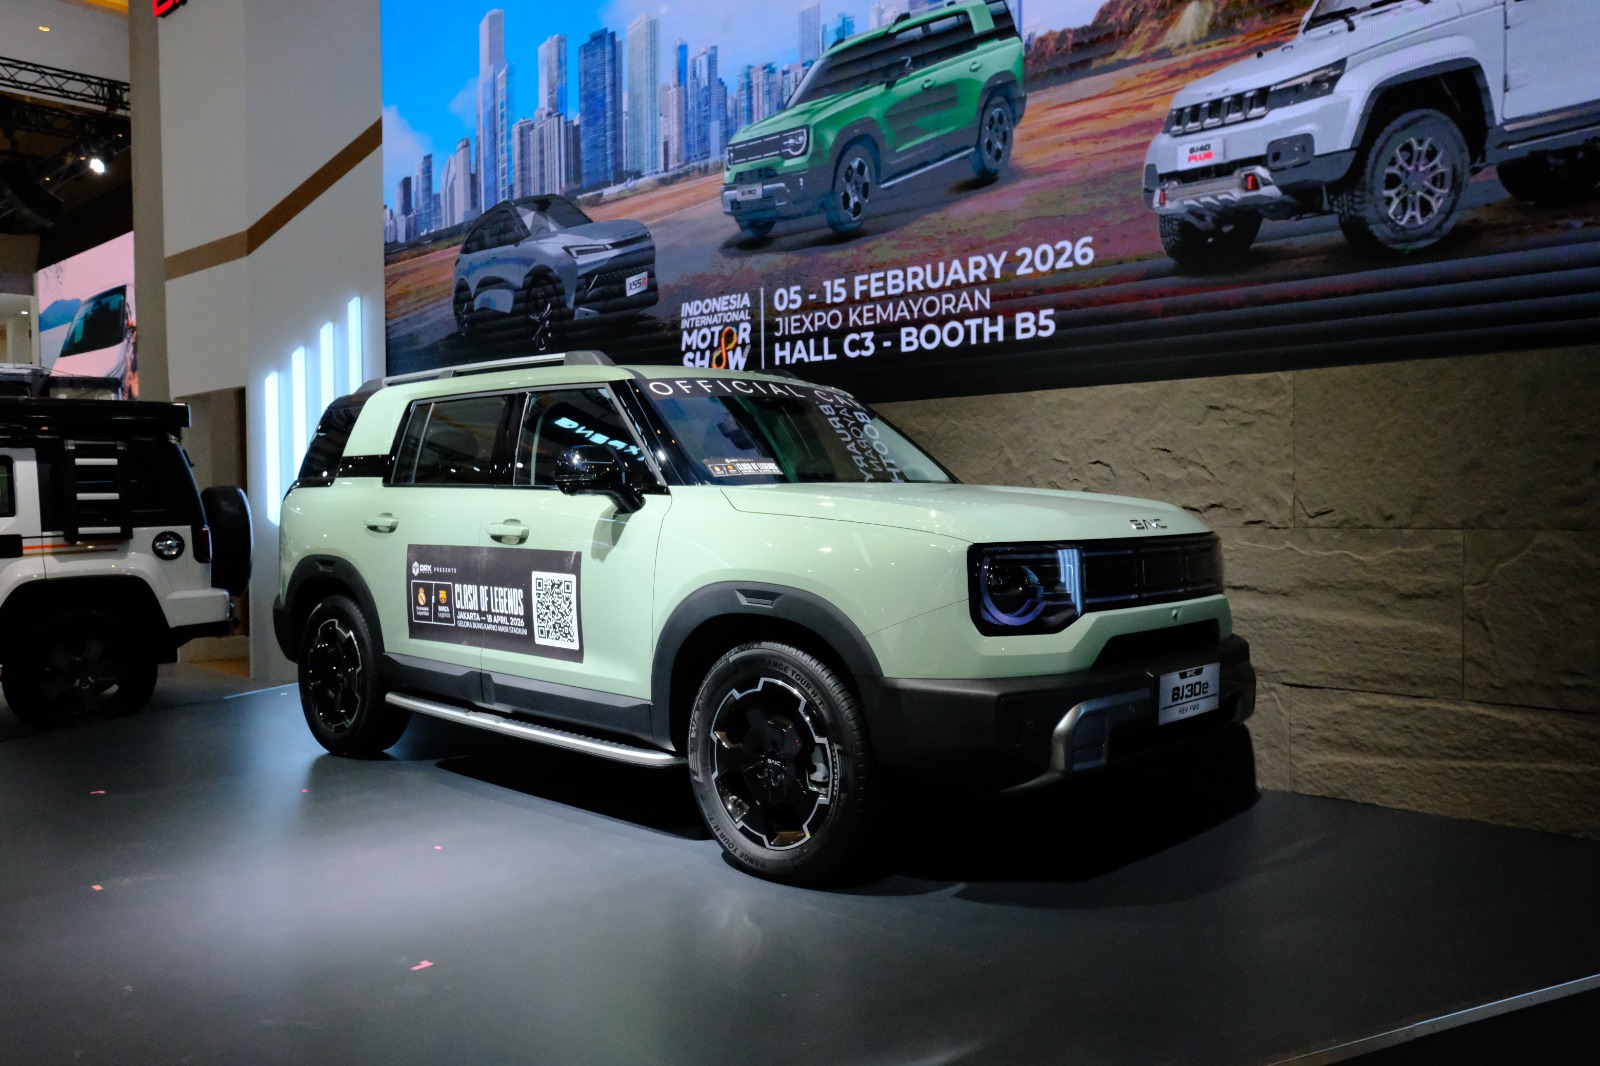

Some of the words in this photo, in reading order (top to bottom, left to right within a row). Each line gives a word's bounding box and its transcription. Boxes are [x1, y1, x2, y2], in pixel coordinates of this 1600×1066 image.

[774, 285, 802, 312] 05
[823, 278, 847, 304] 15
[854, 251, 1008, 300] FEBRUARY
[1015, 236, 1094, 276] 2026
[681, 292, 751, 318] INDONESIA
[774, 309, 842, 337] JIEXPO
[849, 288, 991, 327] KEMAYORAN
[681, 309, 751, 329] INTERNATIONAL
[681, 322, 752, 351] MOTOR
[775, 337, 837, 366] HALL
[843, 332, 875, 358] C3
[901, 315, 1004, 353] BOOTH
[1015, 308, 1056, 340] B5
[649, 380, 806, 398] OFFICIAL
[455, 583, 478, 611] CLASH
[480, 585, 489, 612] OF
[490, 586, 525, 616] LEGENDS
[457, 611, 480, 621] JAKARTA
[493, 615, 509, 625] APRIL
[509, 617, 525, 627] 2026
[1171, 681, 1209, 702] BJ30e
